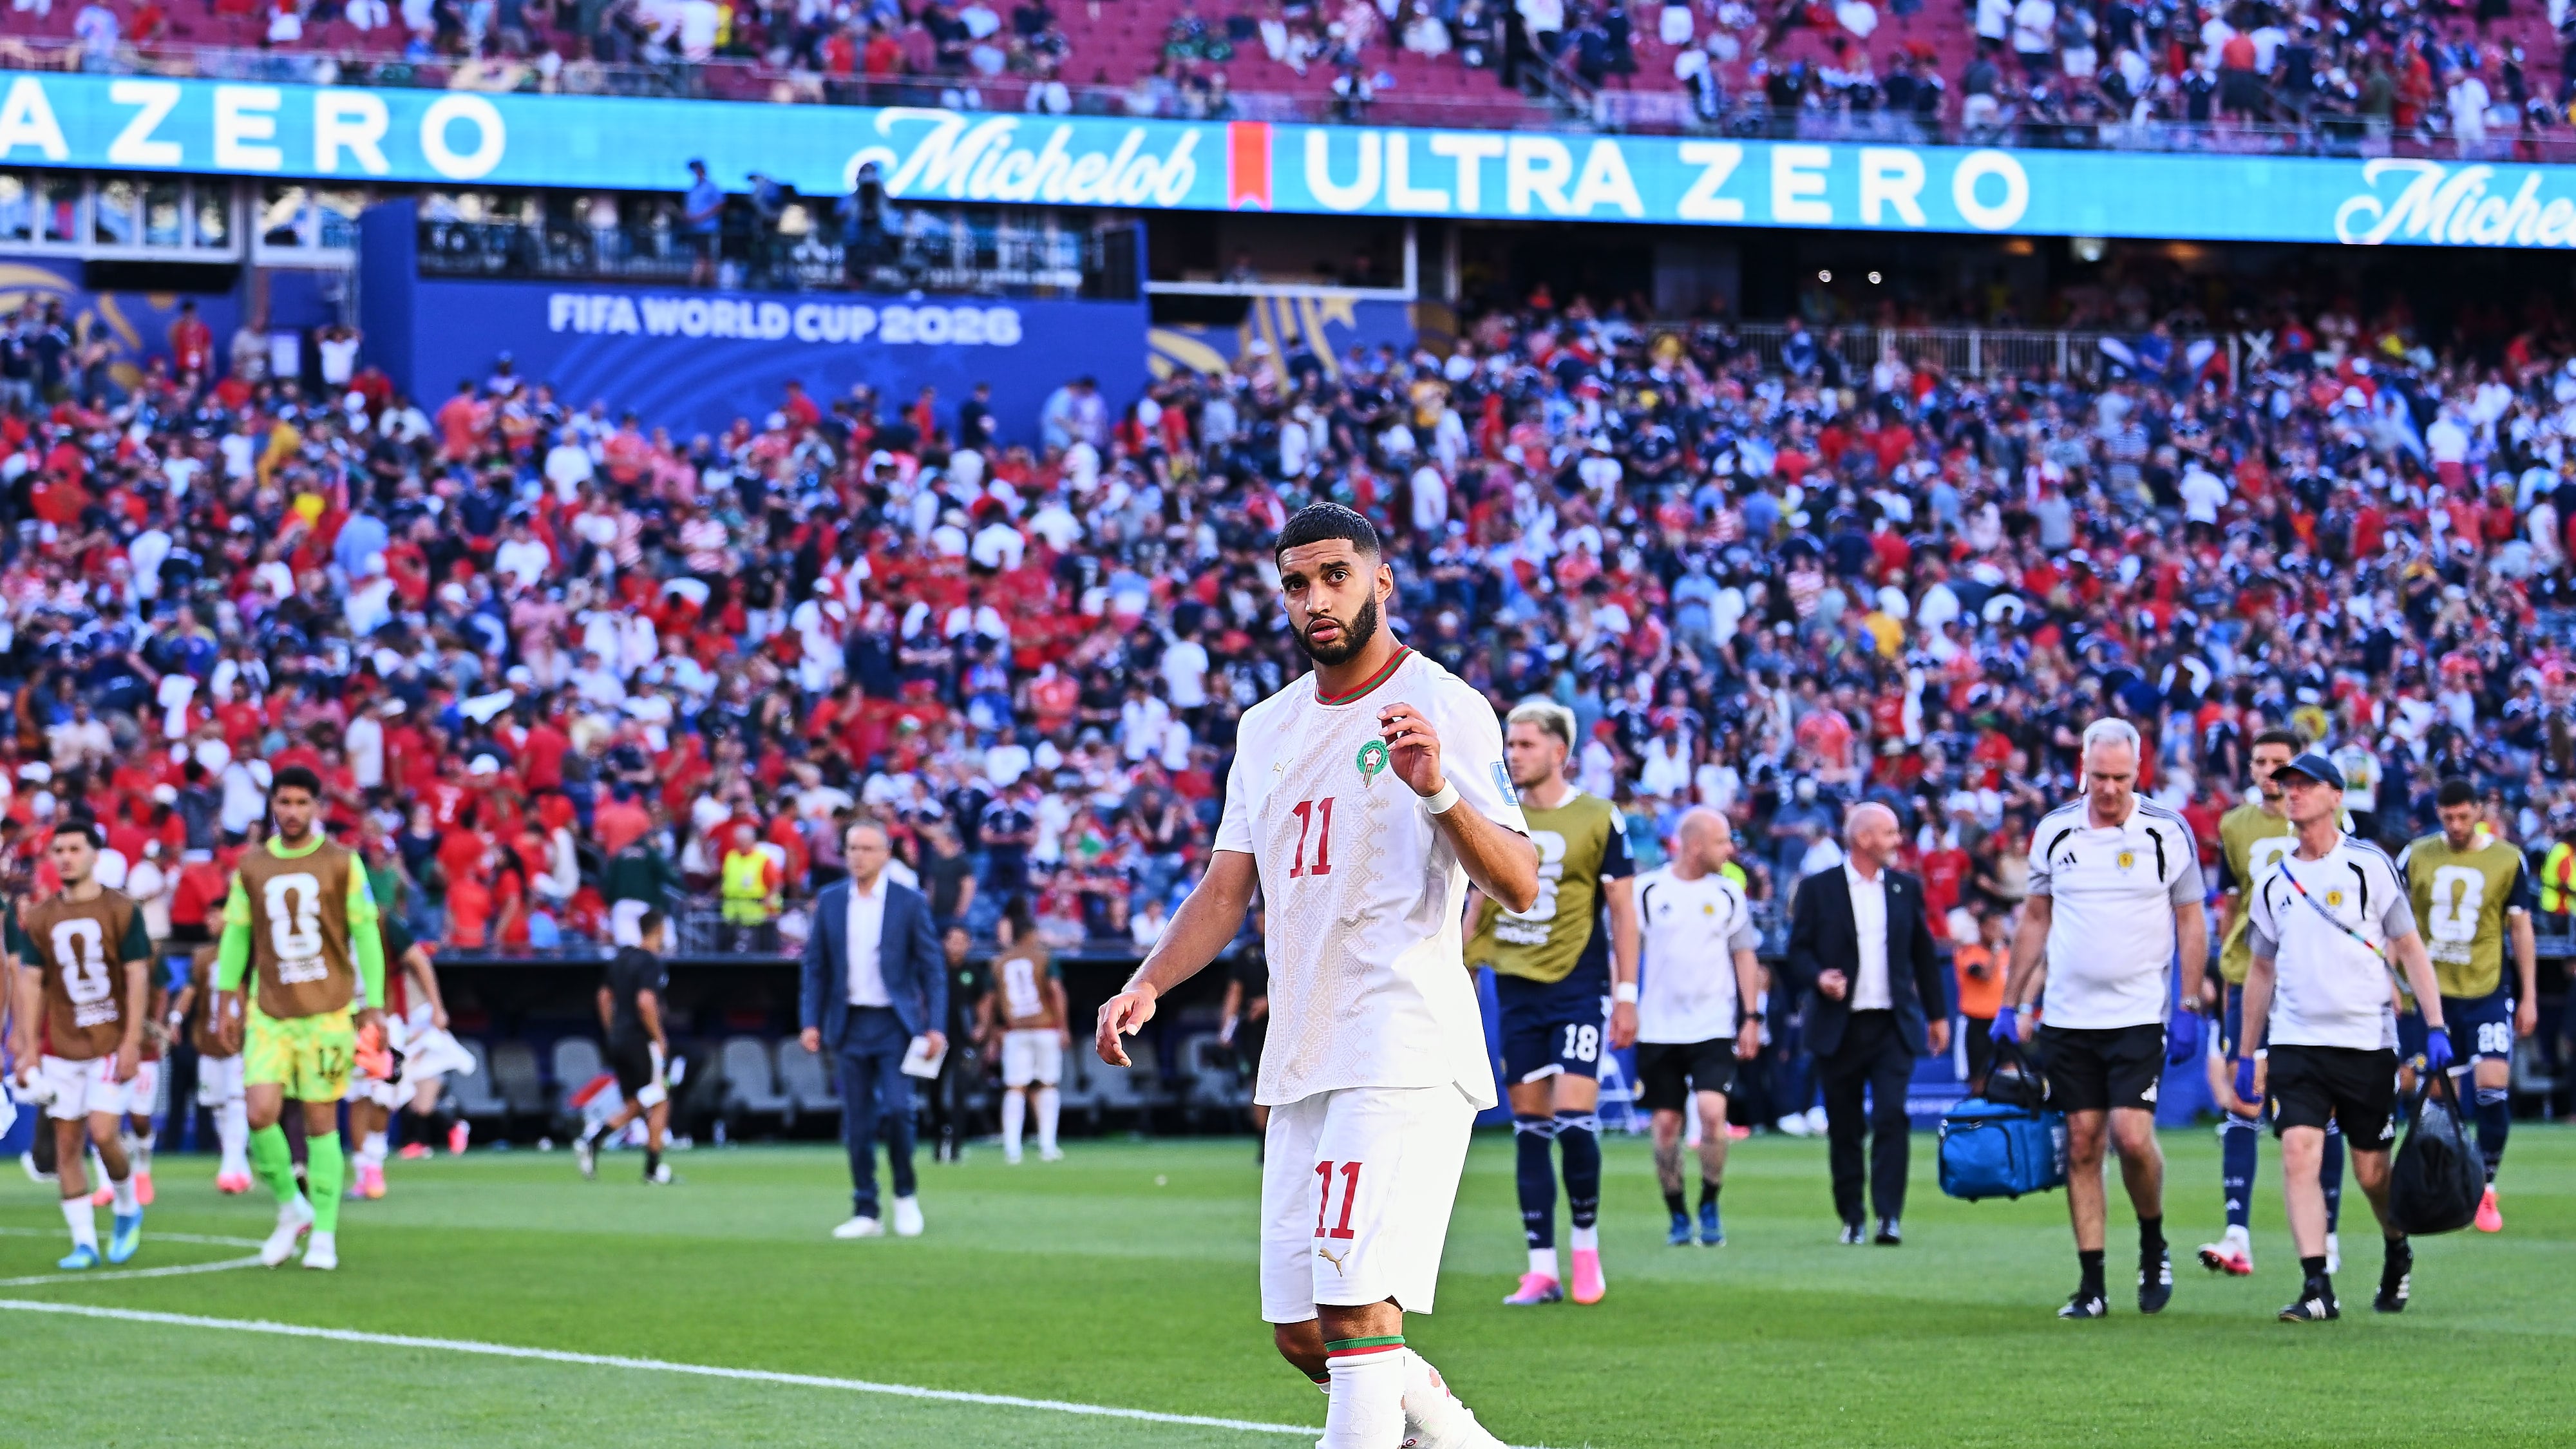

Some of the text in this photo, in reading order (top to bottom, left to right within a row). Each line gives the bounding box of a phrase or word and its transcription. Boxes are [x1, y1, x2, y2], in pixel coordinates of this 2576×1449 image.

[108, 82, 506, 180] ZERO
[844, 108, 2029, 230] Michelob ULTRA ZERO
[2334, 158, 2576, 247] Miche
[549, 294, 1022, 346] FIFA WORLD CUP 2026
[1290, 797, 1334, 878] 11
[1561, 1023, 1598, 1063] 18
[2477, 1021, 2509, 1053] 26
[1315, 1160, 1363, 1240] 11
